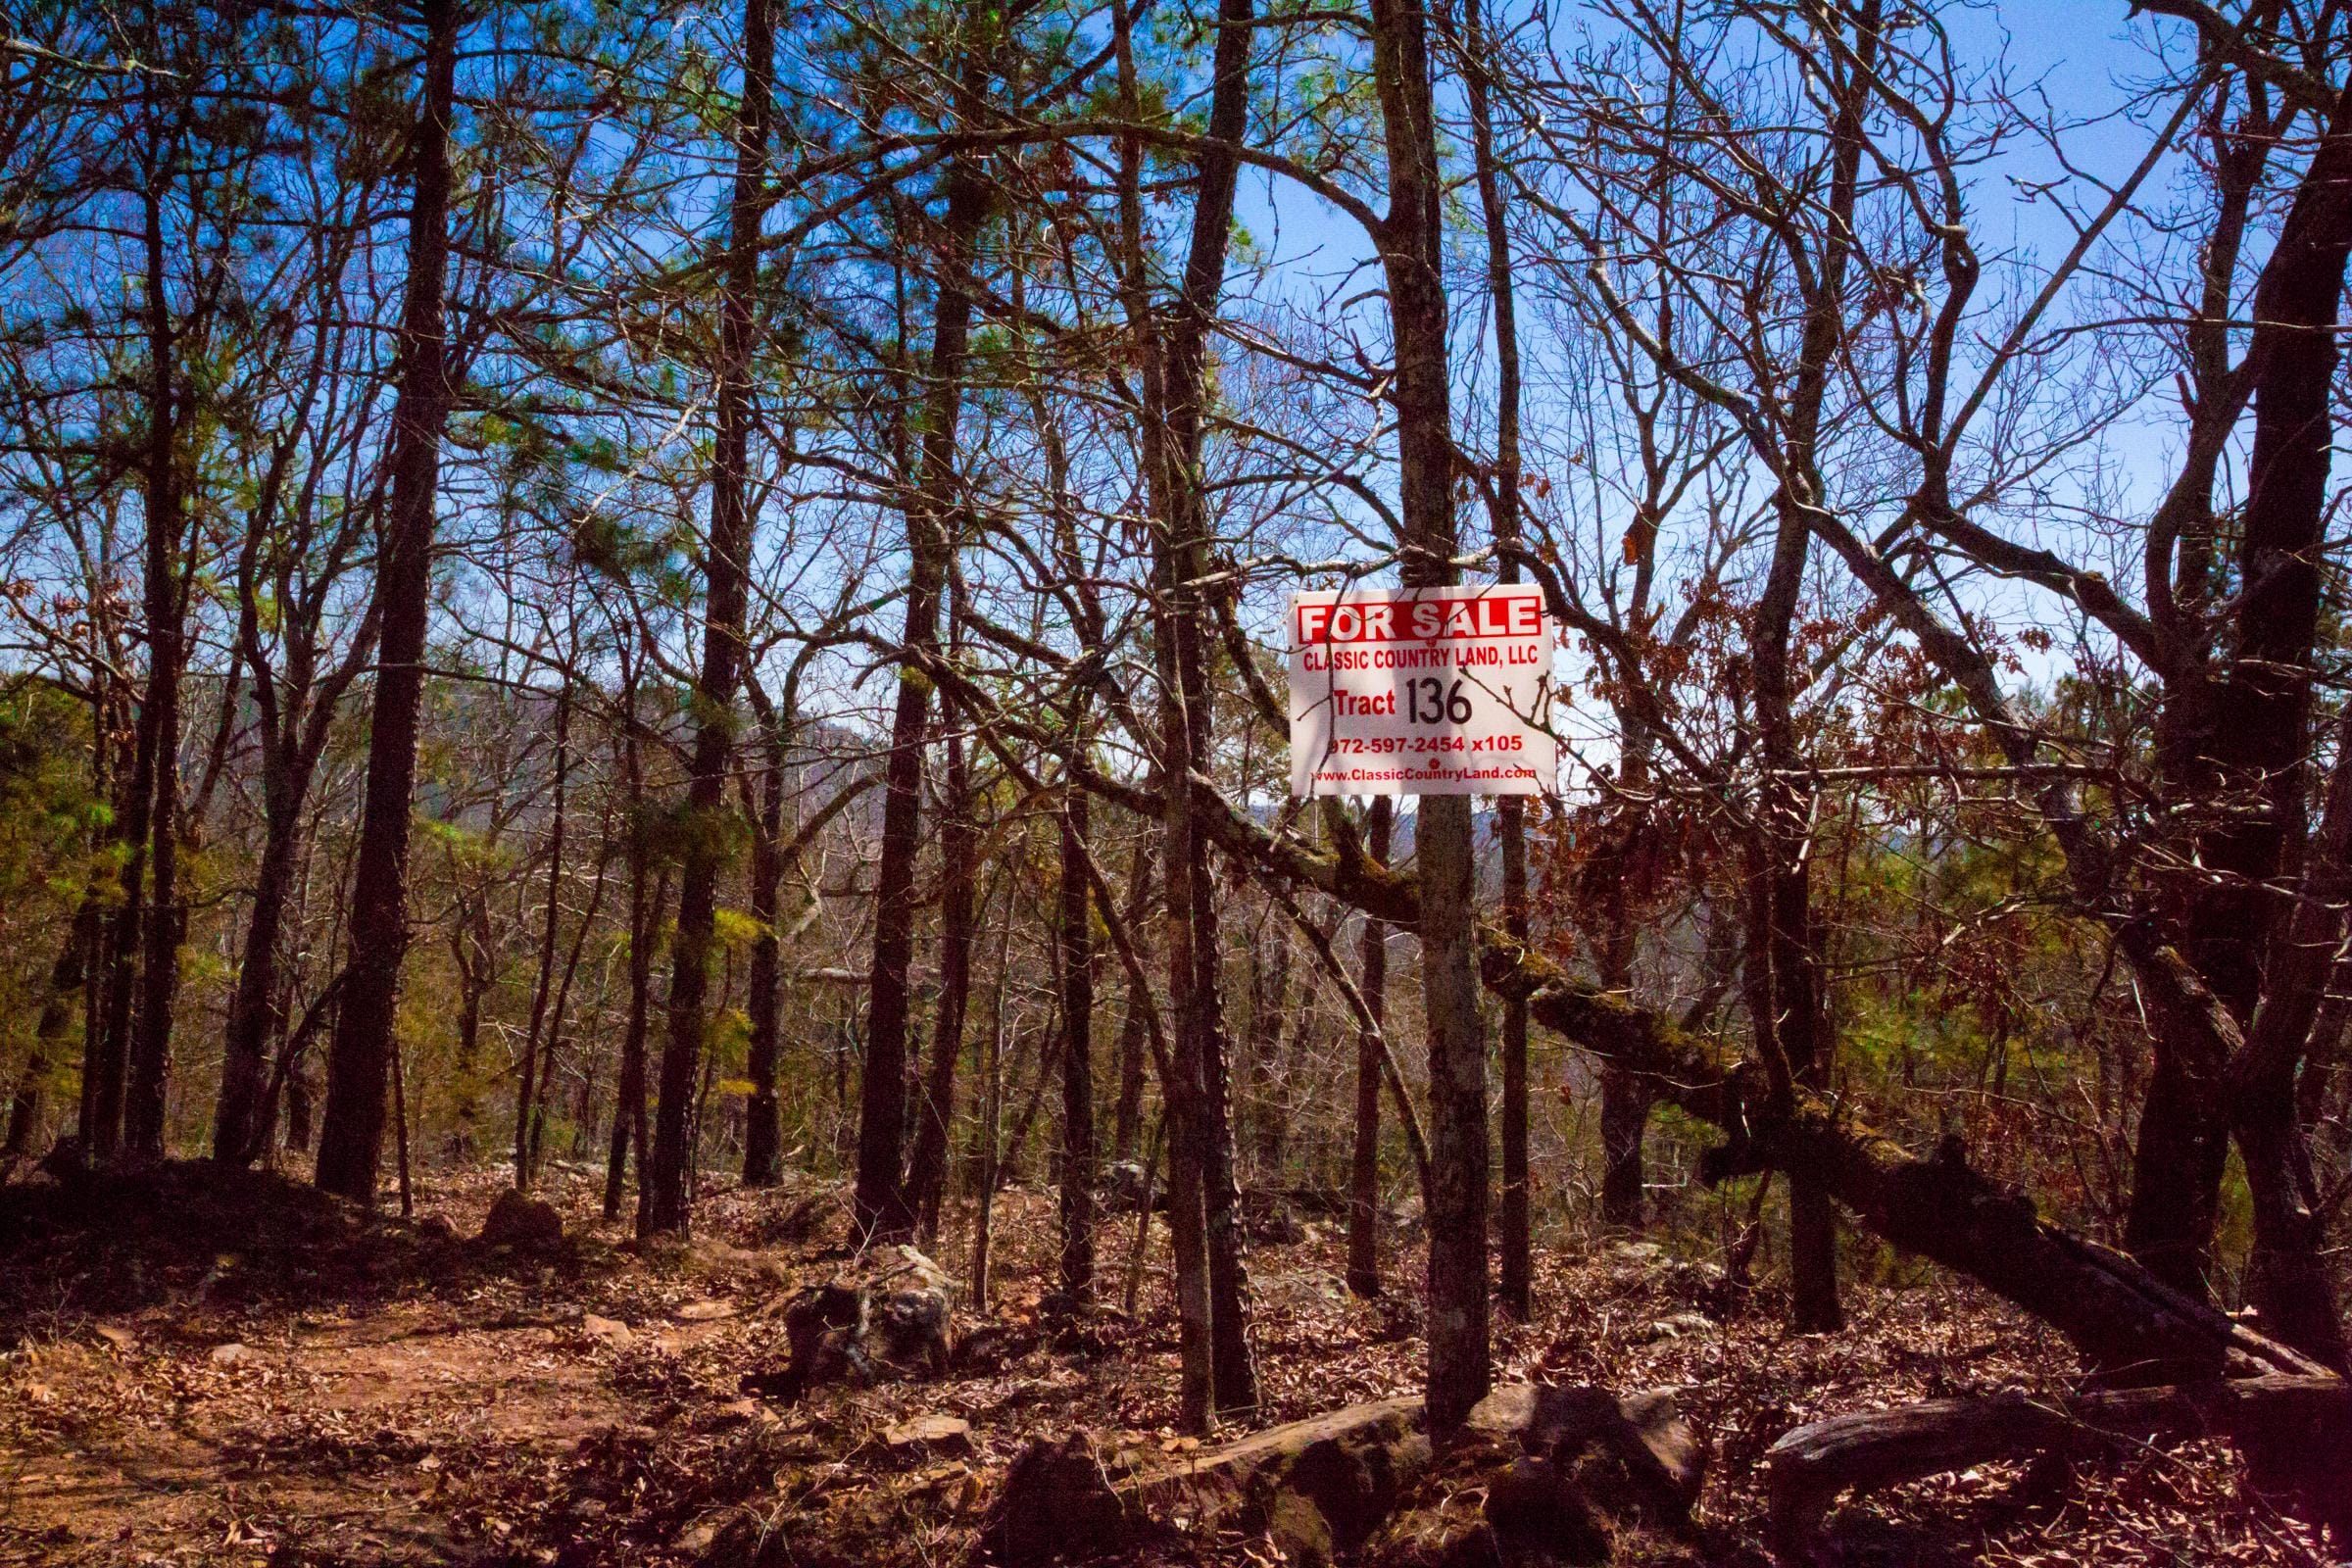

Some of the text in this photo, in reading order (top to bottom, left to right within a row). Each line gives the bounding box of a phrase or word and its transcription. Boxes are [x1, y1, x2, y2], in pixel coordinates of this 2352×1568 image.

[1301, 599, 1537, 642] FOR SALE
[1303, 645, 1538, 671] CLASSIC COUNTRY LAND, LLC
[1334, 677, 1473, 725] Tract 136
[1472, 735, 1523, 752] x105
